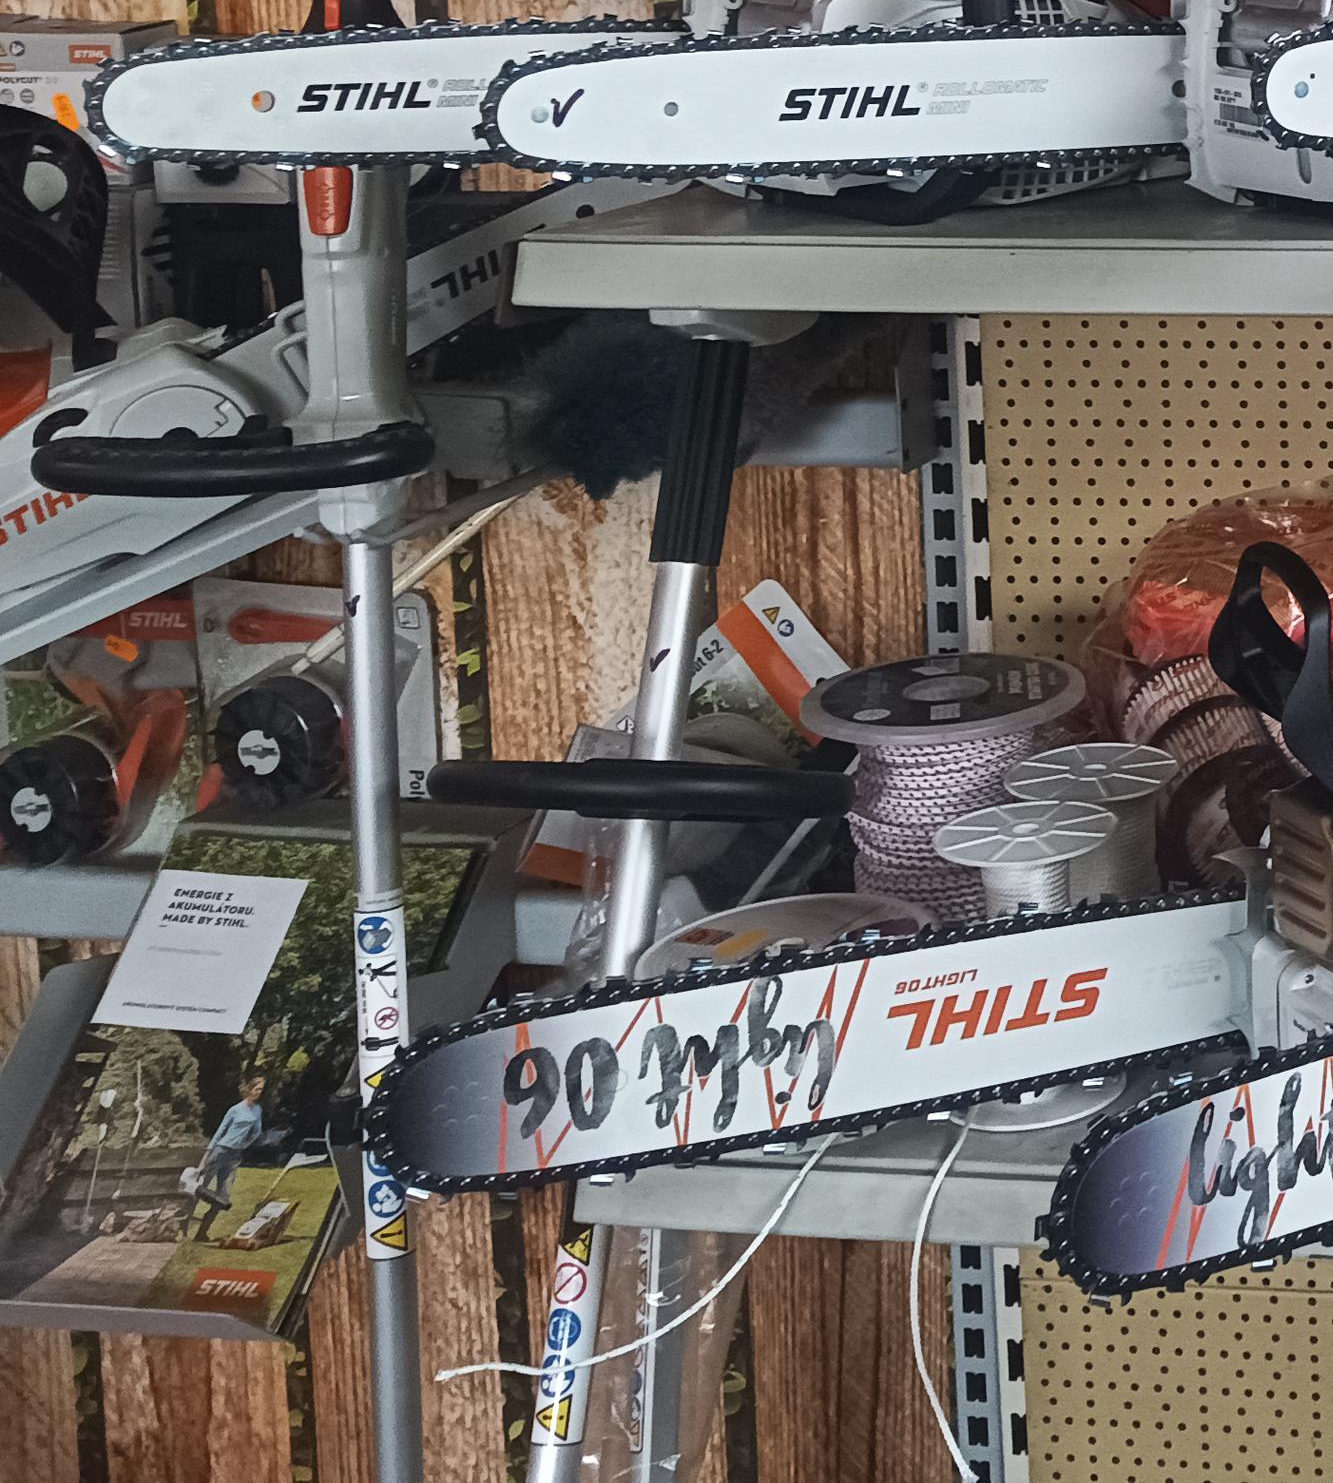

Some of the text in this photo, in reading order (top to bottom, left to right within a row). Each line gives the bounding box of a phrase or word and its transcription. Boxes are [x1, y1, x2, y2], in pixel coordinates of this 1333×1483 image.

[73, 49, 106, 60] STIHL
[296, 81, 431, 113] STIHL
[778, 79, 1049, 121] STIHL ROLLOMATIC
[926, 100, 970, 116] MINI
[128, 611, 188, 628] STIHL
[174, 888, 235, 902] ENERGIE Z
[162, 913, 195, 925] MADE
[197, 916, 214, 926] BY
[887, 966, 1109, 1051] STIHL
[196, 1278, 259, 1298] STIHL
